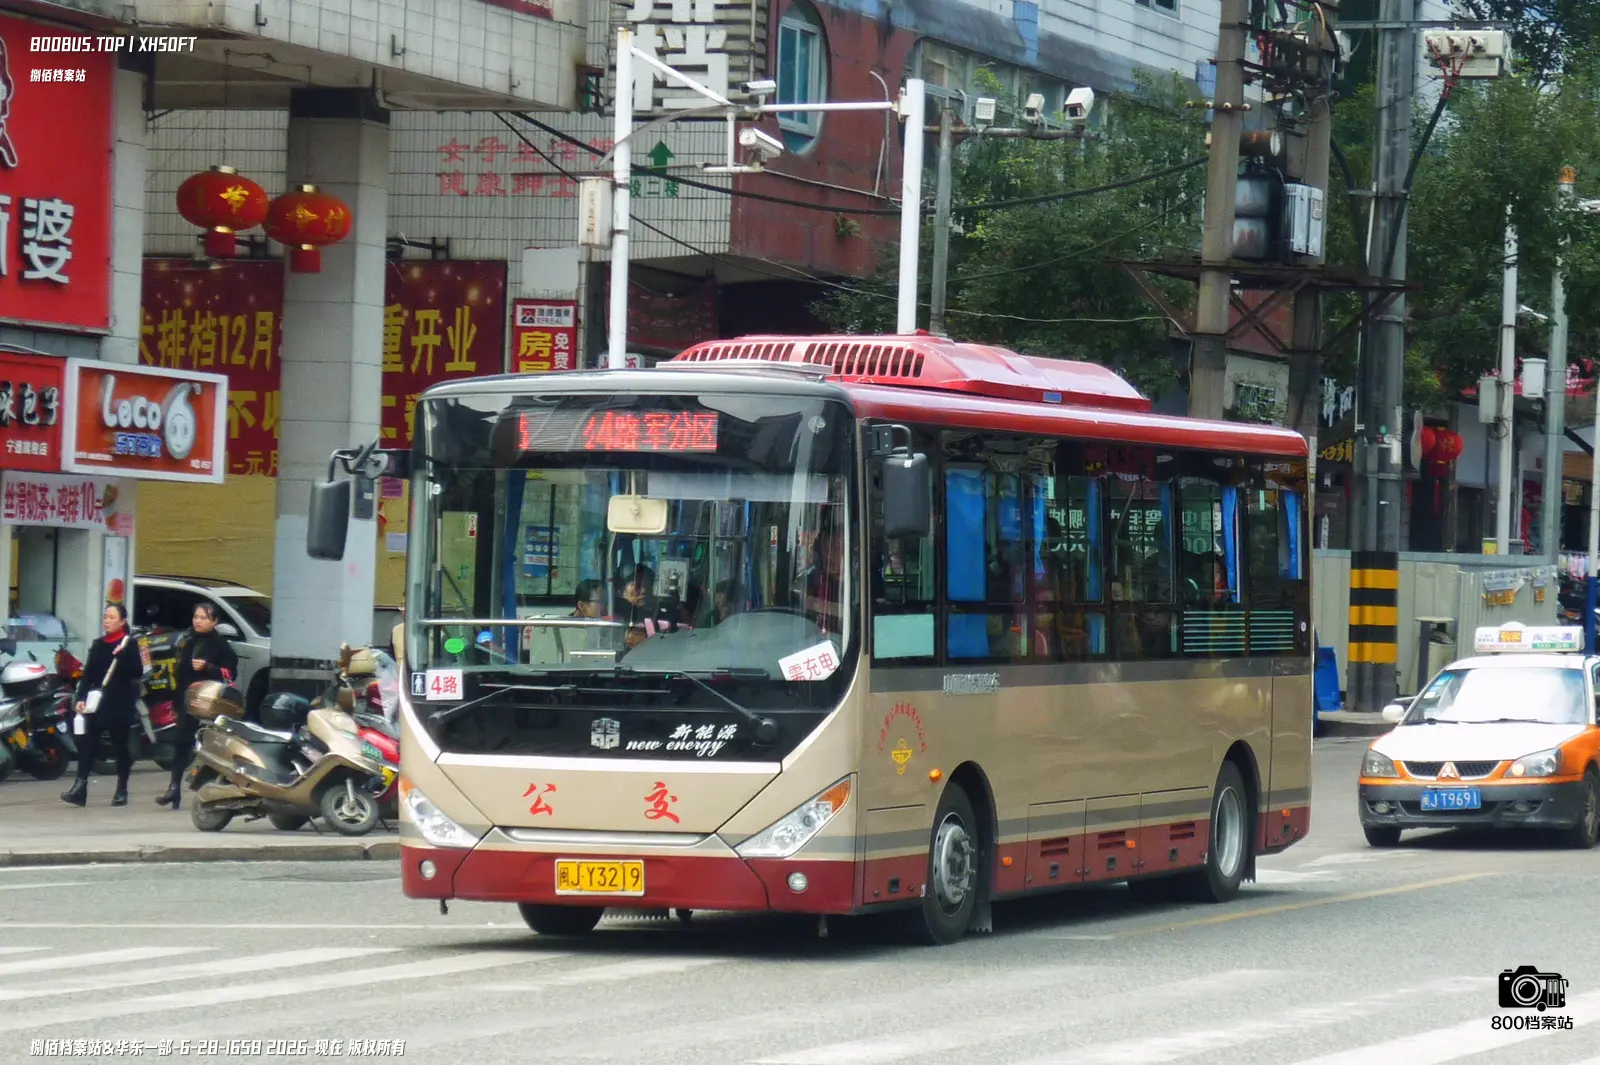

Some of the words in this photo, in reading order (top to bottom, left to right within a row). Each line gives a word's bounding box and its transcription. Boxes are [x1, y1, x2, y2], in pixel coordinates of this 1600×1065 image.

[554, 333, 570, 370] 免费
[788, 653, 837, 681] 需充电
[431, 675, 458, 695] 4路
[669, 723, 738, 740] 新能源
[626, 740, 663, 751] new
[666, 739, 727, 757] energy
